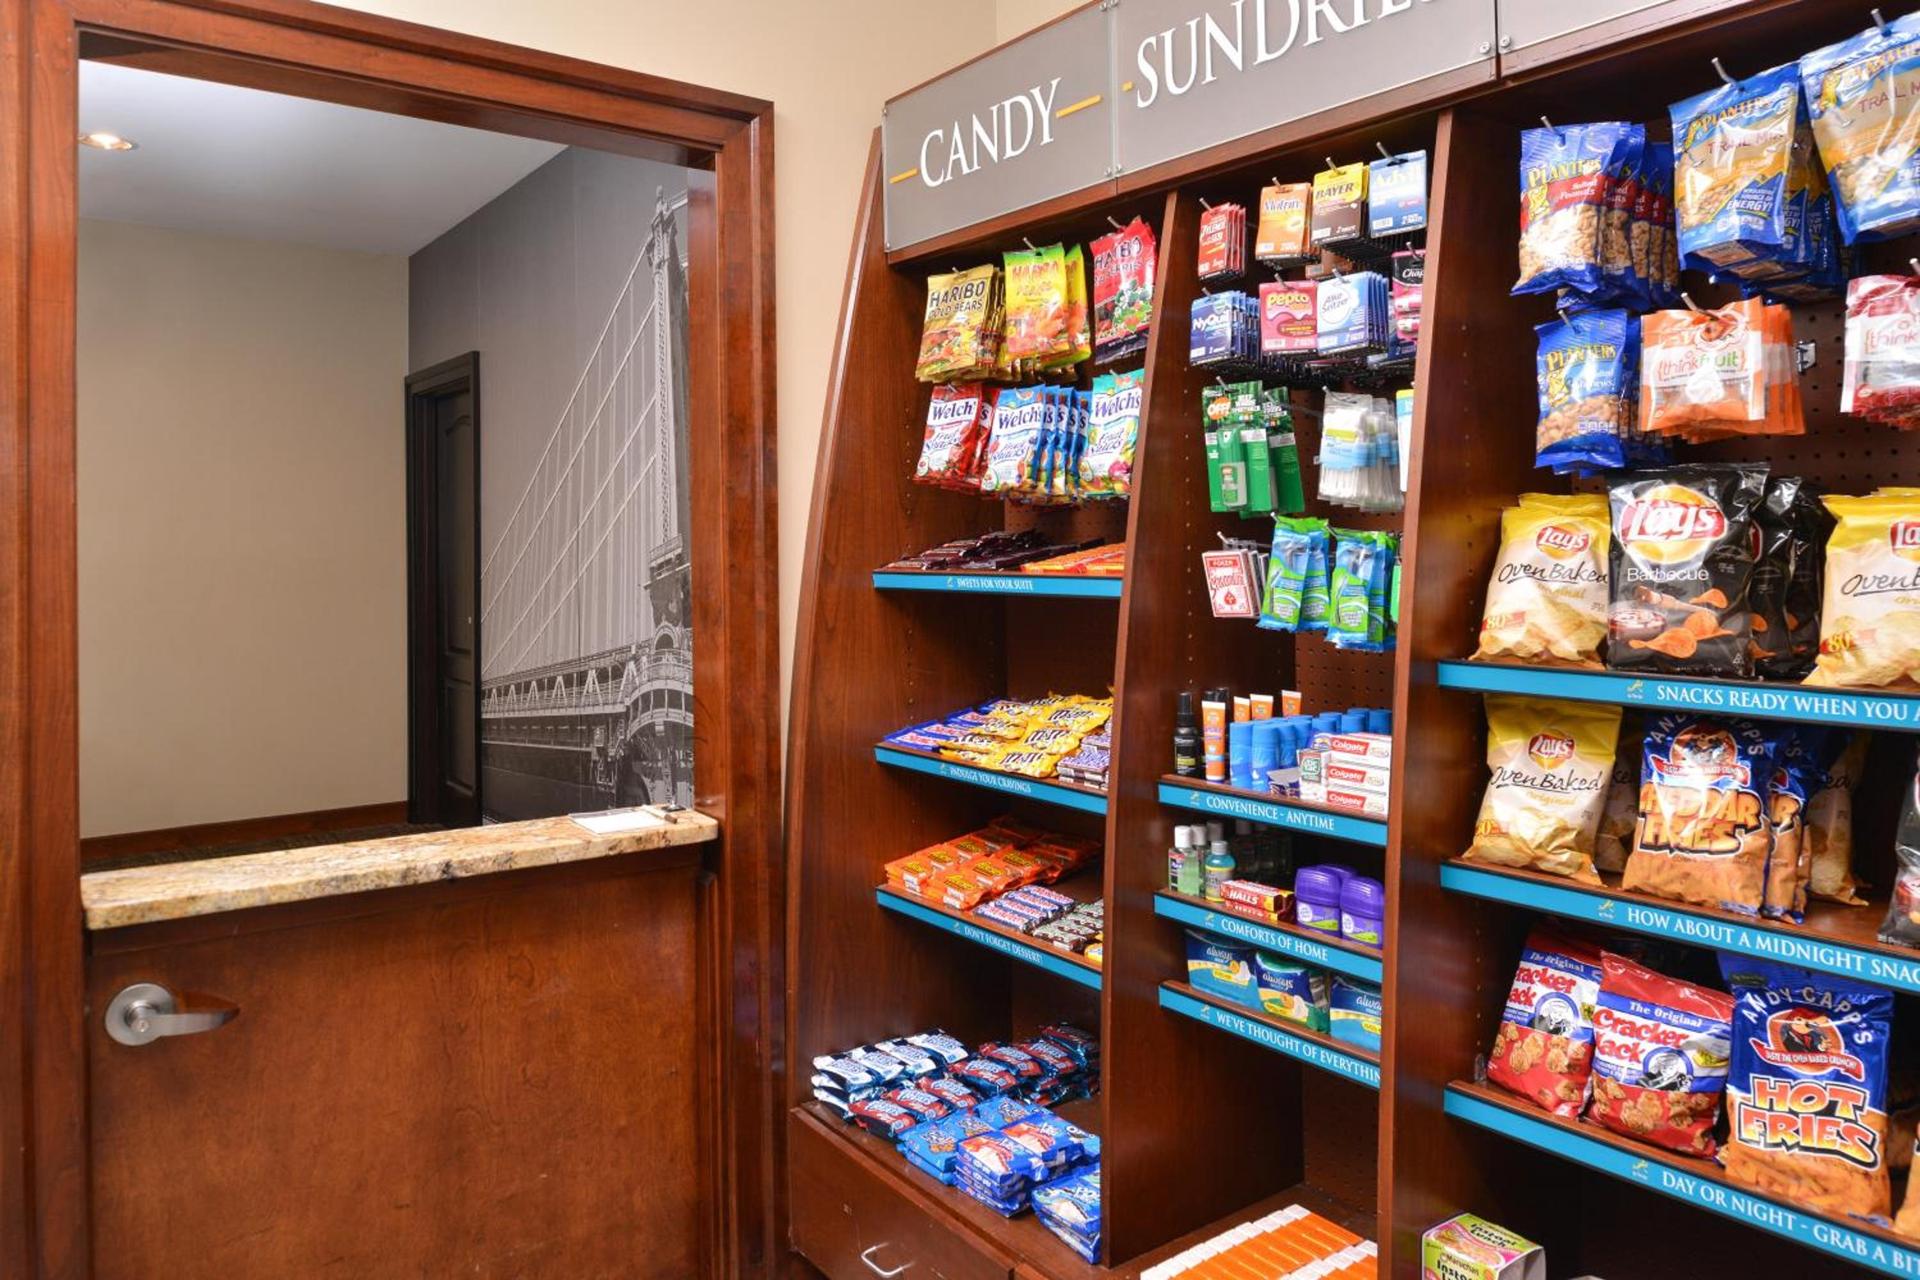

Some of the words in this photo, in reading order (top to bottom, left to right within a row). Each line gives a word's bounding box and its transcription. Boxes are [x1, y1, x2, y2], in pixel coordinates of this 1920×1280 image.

[1136, 0, 1432, 108] SUNDR
[919, 77, 1062, 189] CANDY
[1315, 182, 1354, 199] BAYER
[929, 281, 985, 308] HARIBO
[954, 298, 983, 313] BEARS
[1094, 391, 1140, 418] Welch's
[980, 578, 995, 589] FOR
[995, 579, 1014, 590] YOUR
[1498, 563, 1547, 582] Oven
[1627, 567, 1710, 582] Barbecue
[1841, 574, 1910, 596] Oven
[1656, 684, 1724, 706] SNACKS
[1729, 690, 1794, 712] READY
[1793, 695, 1857, 716] WHEN
[1861, 700, 1908, 721] YOU
[1332, 740, 1366, 752] Colgate
[1329, 768, 1363, 779] Colgate
[1490, 766, 1537, 787] Oven
[1539, 768, 1605, 792] Baked
[1329, 794, 1363, 806] Colgate
[1206, 796, 1279, 820] CONVENIENCE
[1286, 811, 1335, 831] ANYTIME
[1229, 889, 1259, 905] HALLS
[1221, 918, 1276, 948] COMFORTS
[1277, 934, 1293, 950] OF
[1296, 941, 1328, 961] HOME
[1628, 907, 1671, 927] HOW
[1674, 917, 1734, 945] ABOUT
[1739, 932, 1751, 947] A
[1755, 934, 1866, 972] MIDNIGHT
[1206, 945, 1233, 963] always
[1530, 951, 1544, 961] The
[1544, 955, 1585, 972] Original
[1261, 972, 1294, 991] always
[1630, 1001, 1651, 1014] The
[1654, 1008, 1703, 1027] Original
[1742, 987, 1793, 1024] ANDY
[1801, 986, 1873, 1045] CAPP'S
[1216, 1011, 1245, 1034] WE'VE
[1247, 1021, 1301, 1050] THOUGHT
[1302, 1044, 1318, 1059] OF
[1592, 1008, 1690, 1048] Cracker
[1781, 1052, 1792, 1062] THE
[1809, 1055, 1828, 1064] BAKED
[1753, 1078, 1864, 1120] HOT
[1741, 1107, 1877, 1165] FRIES
[1663, 1169, 1696, 1196] DAY
[1700, 1185, 1728, 1208] OR
[1731, 1194, 1797, 1230] NIGHT
[1813, 1224, 1868, 1257] GRAB
[1872, 1245, 1887, 1264] A
[1470, 1229, 1506, 1247] Lunch
